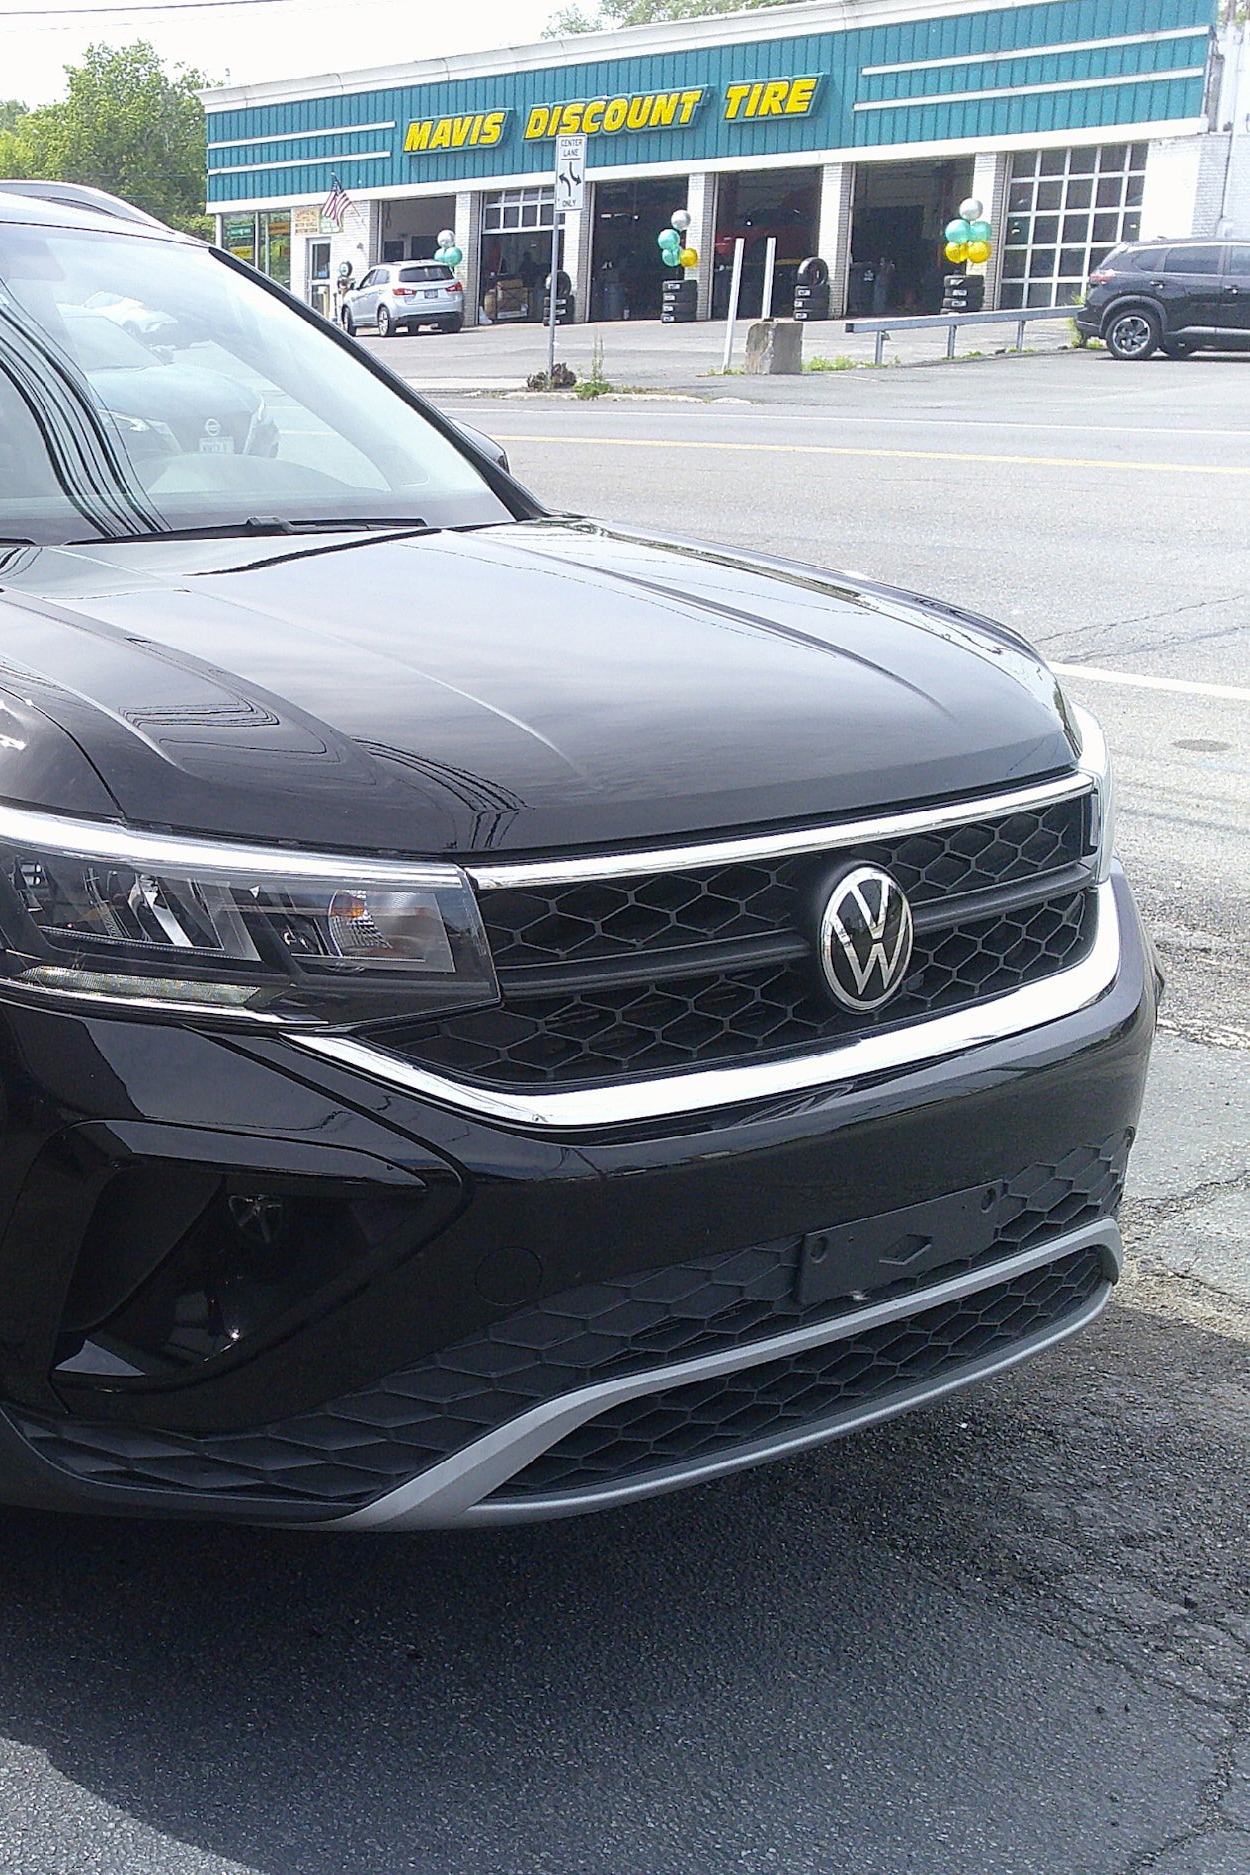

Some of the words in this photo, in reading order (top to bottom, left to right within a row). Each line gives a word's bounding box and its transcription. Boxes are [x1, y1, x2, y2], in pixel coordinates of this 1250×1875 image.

[403, 111, 507, 152] MAVIS
[524, 90, 703, 140] DISCOUNT
[724, 78, 819, 120] TIRE
[560, 138, 583, 147] CENTER
[563, 148, 579, 157] LANE
[562, 199, 577, 208] ONLY
